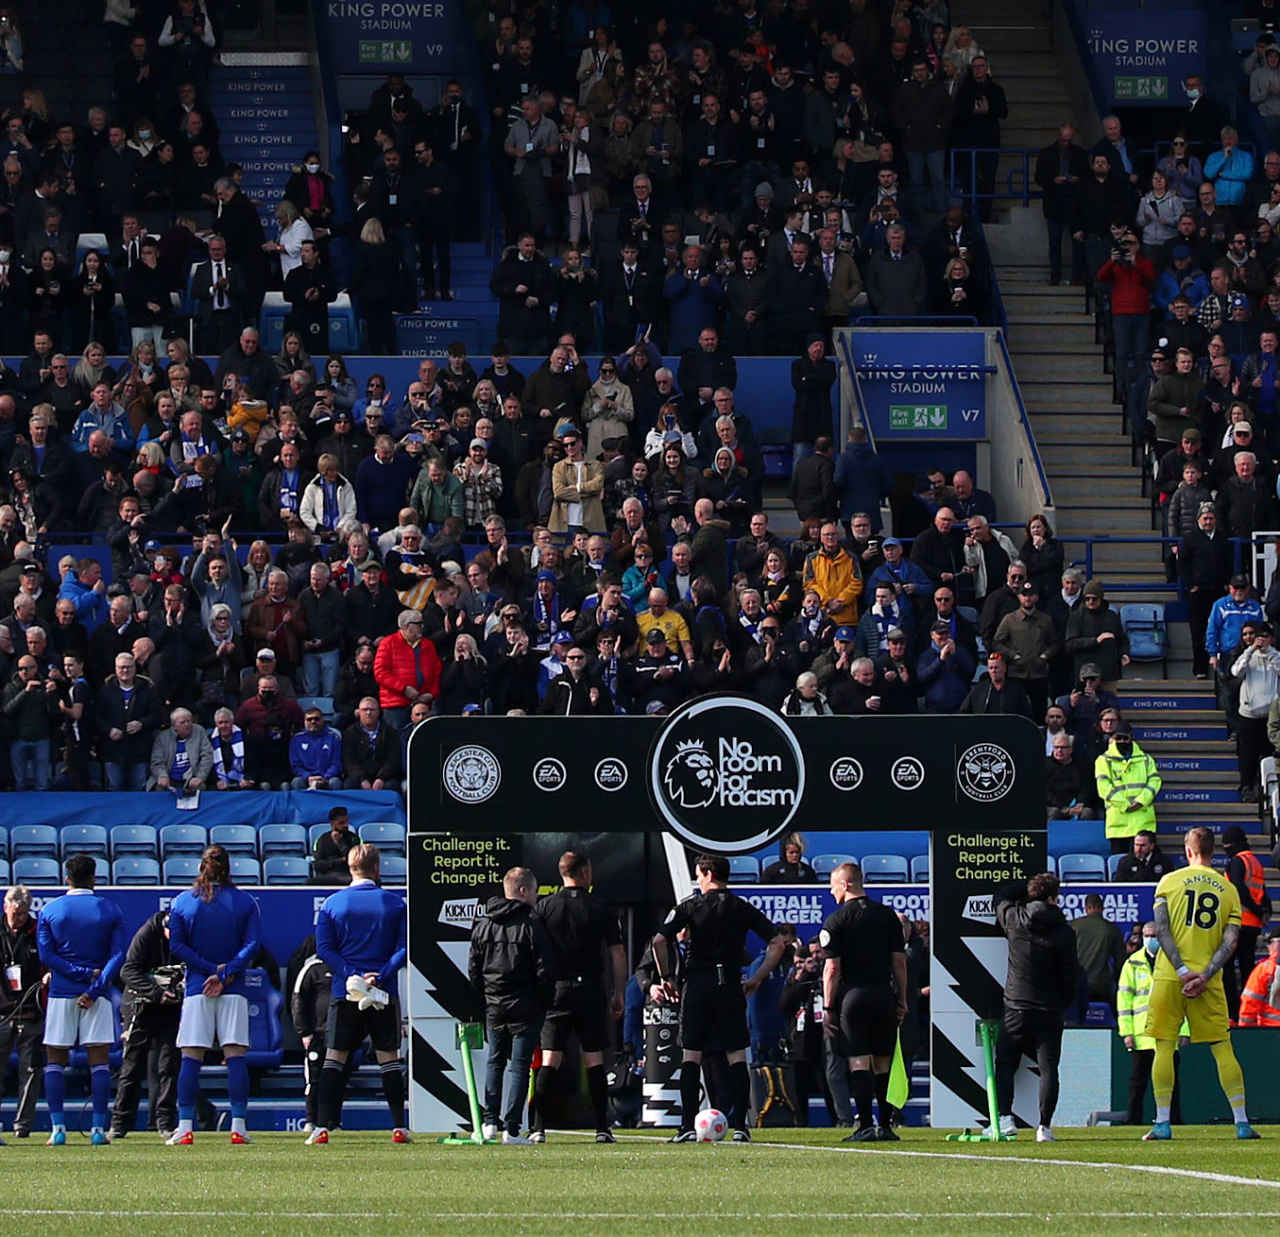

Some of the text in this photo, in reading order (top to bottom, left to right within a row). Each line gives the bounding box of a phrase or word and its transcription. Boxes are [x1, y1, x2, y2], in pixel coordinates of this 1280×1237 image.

[328, 3, 445, 18] KING POWER
[360, 20, 412, 30] STADIUM
[426, 45, 443, 56] V9
[1135, 40, 1198, 53] POWER
[1115, 56, 1166, 66] STADIUM
[228, 83, 285, 92] KING POWER
[231, 109, 288, 117] KING POWER
[234, 135, 292, 144] KING POWER
[424, 320, 458, 328] POWER
[890, 382, 946, 394] STADIUM
[892, 409, 909, 417] Fire
[961, 409, 980, 422] V7
[892, 418, 909, 426] exit
[719, 737, 752, 758] No
[965, 745, 1007, 761] BRENTFORD
[448, 750, 496, 773] LEICESTER CITY
[720, 755, 781, 772] room
[539, 764, 559, 776] EA
[600, 764, 620, 776] EA
[836, 764, 856, 776] EA
[897, 764, 917, 776] EA
[538, 775, 561, 783] SPORTS
[599, 775, 622, 783] SPORTS
[720, 771, 752, 791] for
[835, 775, 858, 783] SPORTS
[896, 775, 919, 783] SPORTS
[448, 775, 496, 799] FOOTBALL CLUB
[720, 788, 795, 806] racism
[422, 837, 511, 854] Challenge it.
[946, 833, 1035, 850] Challenge it.
[434, 854, 500, 870] Report it.
[959, 850, 1024, 866] Report it.
[431, 870, 503, 886] Change it.
[955, 866, 1027, 882] Change it.
[1183, 875, 1225, 893] JANSSON
[445, 904, 476, 917] KICK IT
[969, 900, 991, 913] KICK
[1185, 889, 1220, 930] 18
